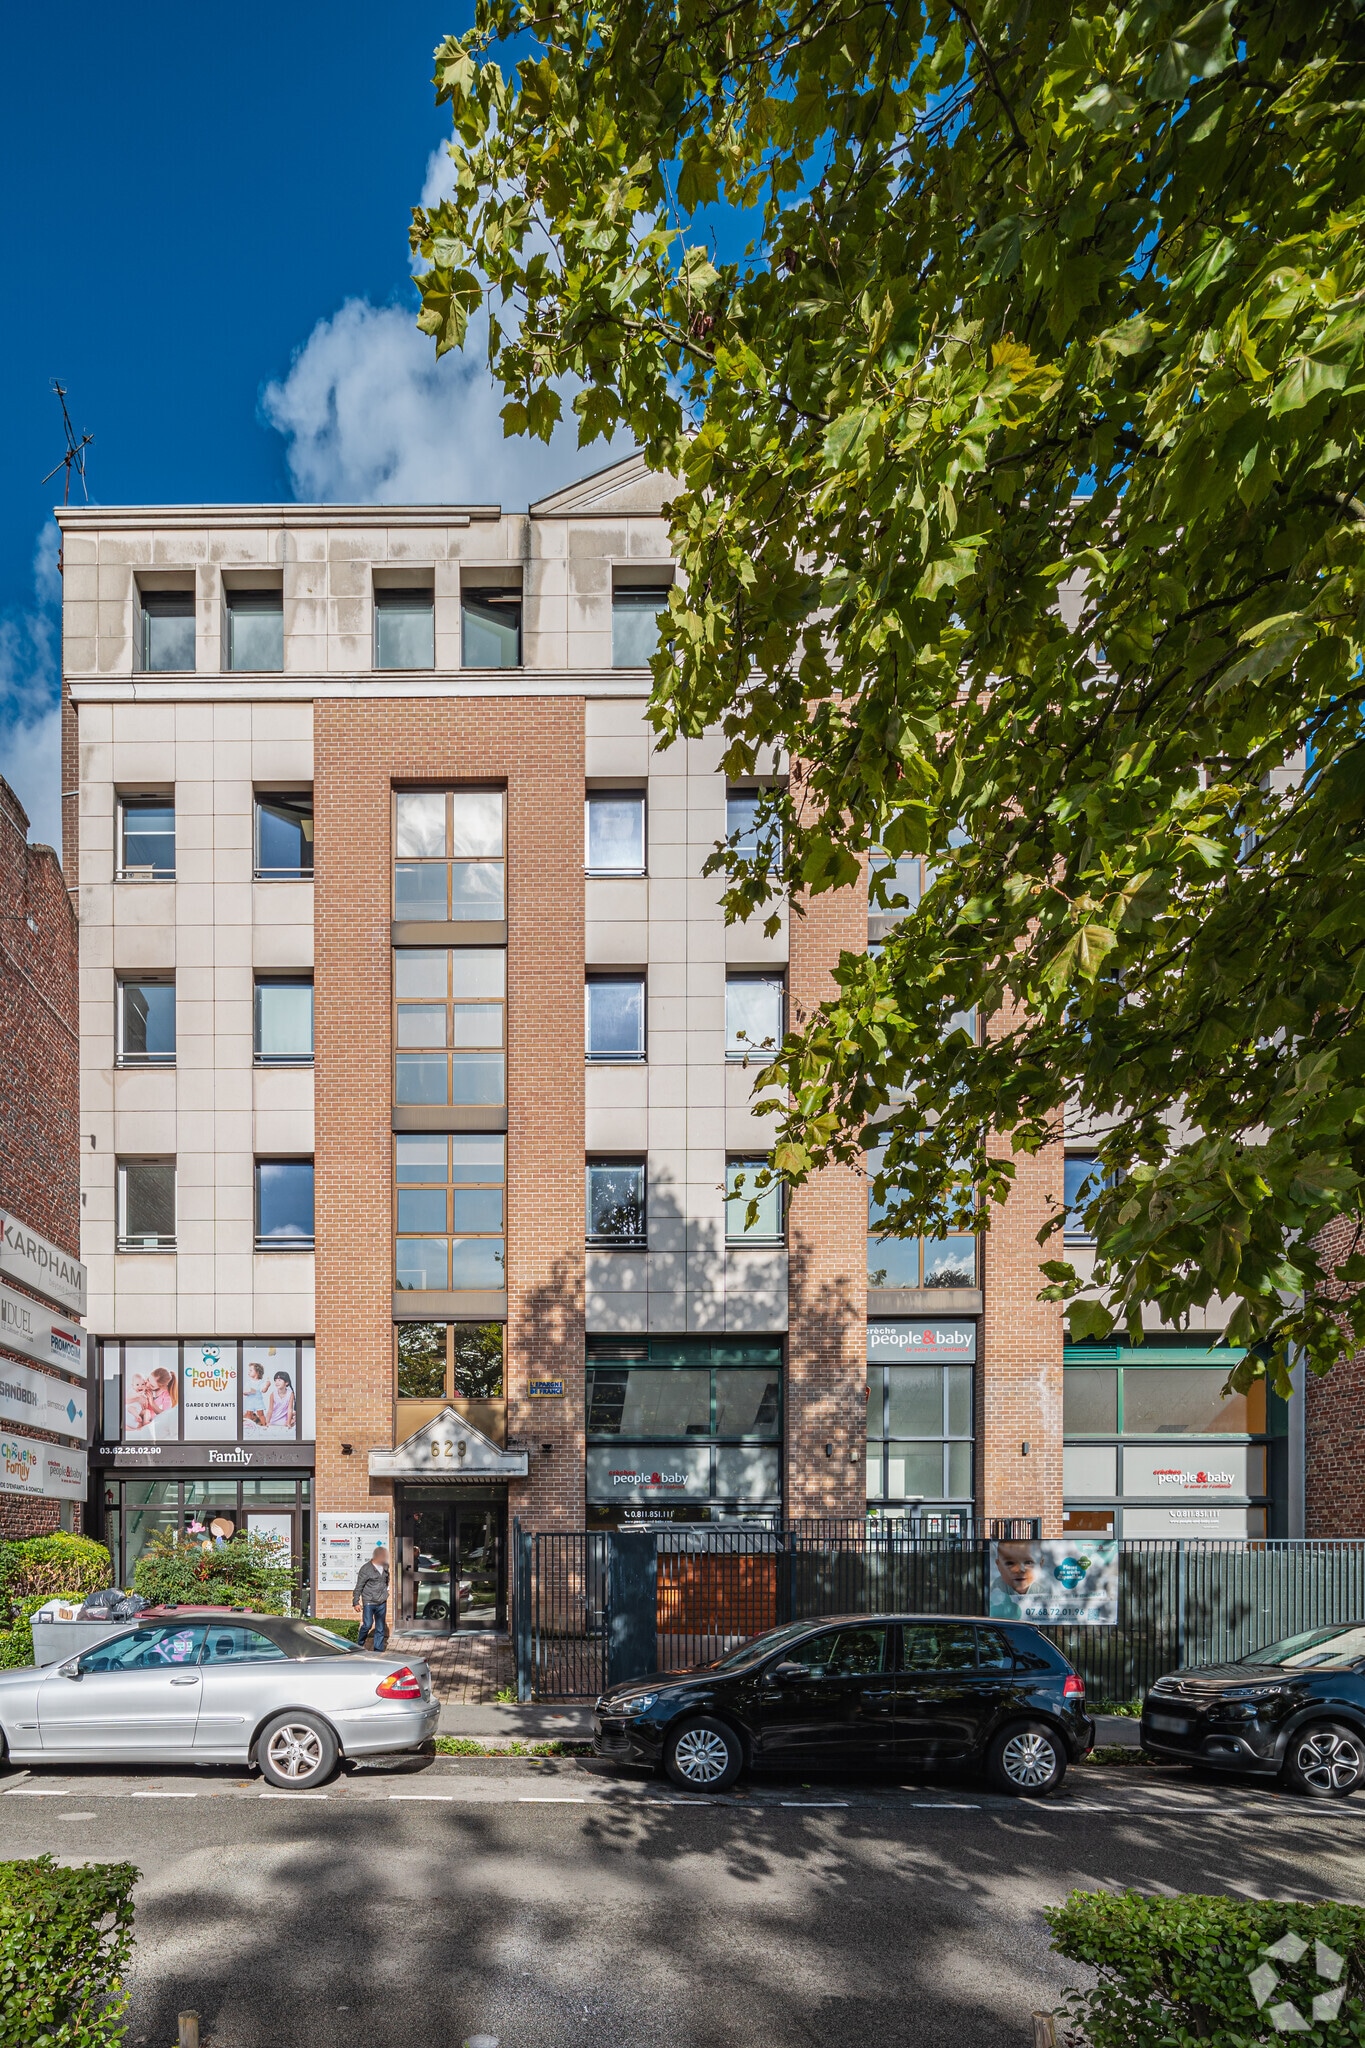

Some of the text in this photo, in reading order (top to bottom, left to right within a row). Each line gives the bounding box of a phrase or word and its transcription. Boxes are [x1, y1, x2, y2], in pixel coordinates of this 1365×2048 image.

[0, 1220, 81, 1291] KARDHAM
[871, 1330, 973, 1348] people&baby
[185, 1367, 236, 1379] Chouette
[192, 1378, 228, 1391] Family
[209, 1447, 253, 1465] Family
[431, 1440, 467, 1457] 629
[6, 1460, 30, 1481] Family
[613, 1472, 689, 1486] people&baby
[1158, 1472, 1235, 1485] people&baby
[1026, 1608, 1084, 1616] 07.68.72.01.96
